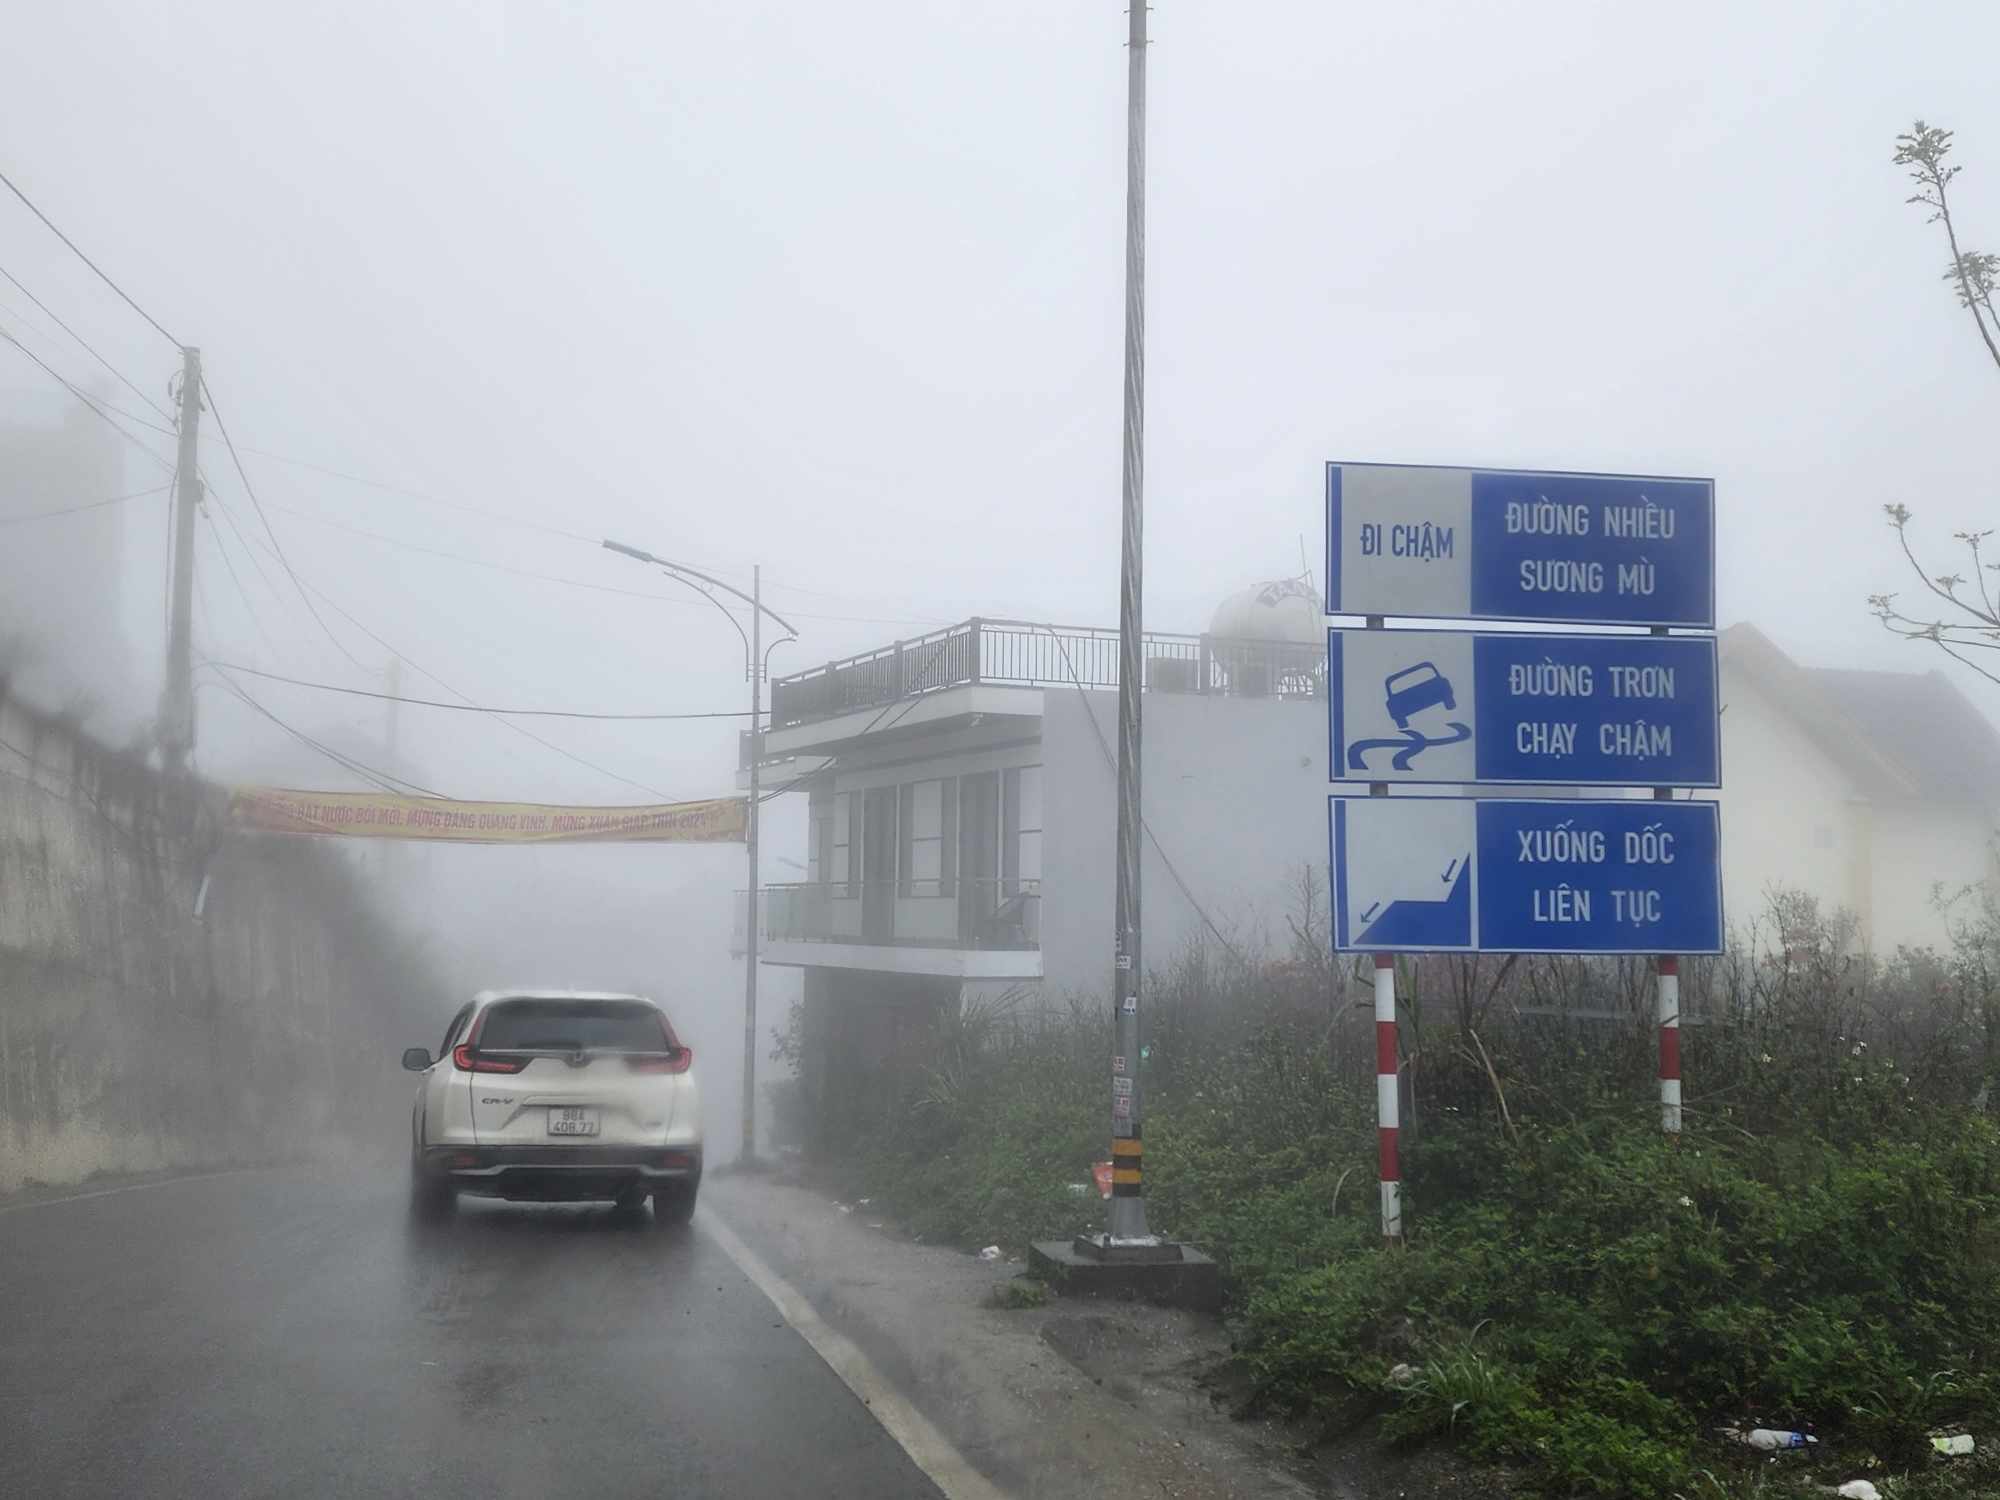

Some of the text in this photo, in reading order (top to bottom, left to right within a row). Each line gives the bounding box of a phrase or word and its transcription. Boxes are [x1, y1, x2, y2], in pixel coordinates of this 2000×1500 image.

[1504, 495, 1675, 539] ĐƯỜNG NHIỀU
[1360, 521, 1454, 563] ĐI CHẬM
[1520, 555, 1655, 596] SƯƠNG MÙ
[1508, 656, 1675, 699] ĐƯỜNG TRƠN
[1516, 719, 1672, 761] CHẠY CHẬM
[1517, 819, 1675, 864] XUỐNG DỐC
[1533, 882, 1661, 928] LIÊN TỤC
